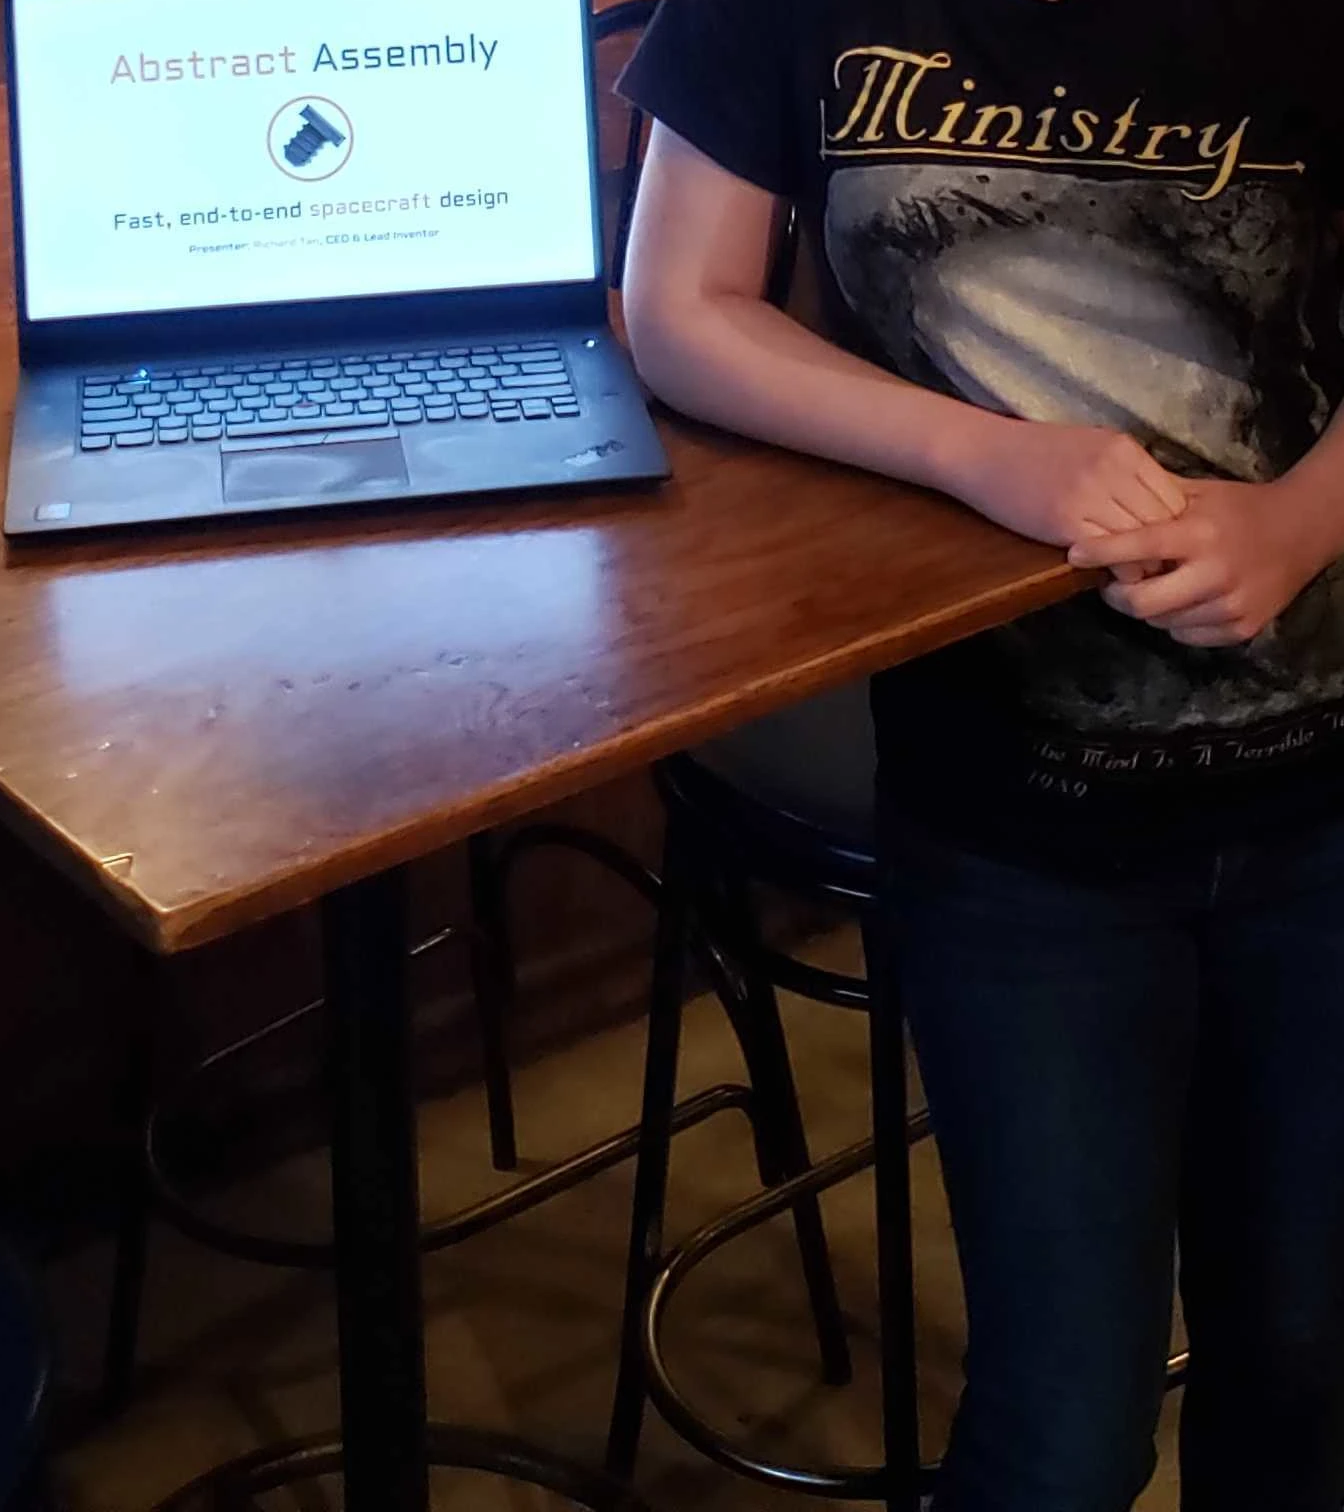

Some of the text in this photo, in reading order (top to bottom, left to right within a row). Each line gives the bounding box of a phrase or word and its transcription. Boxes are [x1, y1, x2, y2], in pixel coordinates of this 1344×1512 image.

[109, 32, 499, 86] Abstract Assembly
[827, 45, 1252, 202] Ministry
[113, 188, 510, 231] Fast, end-to-end spacecraft design
[325, 234, 350, 245] CEO
[364, 231, 391, 242] Lead
[393, 229, 440, 241] Inventor
[1224, 727, 1315, 760] Terrible
